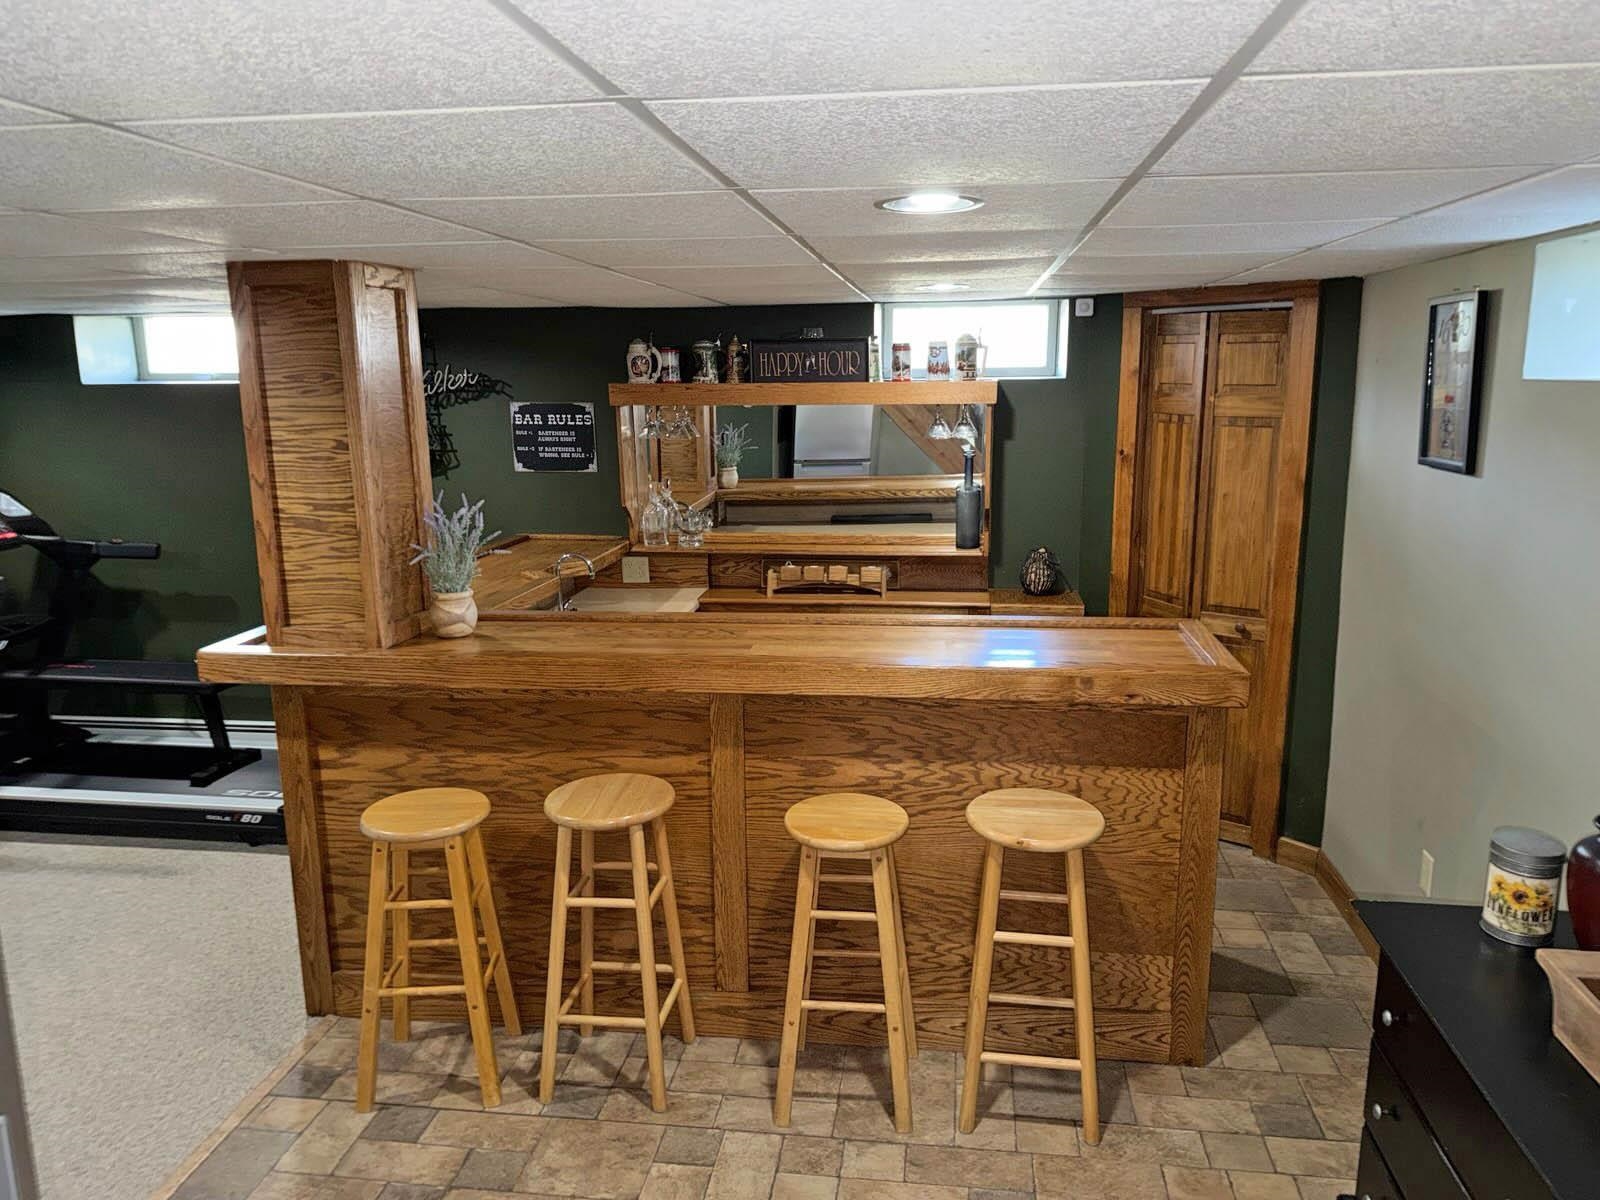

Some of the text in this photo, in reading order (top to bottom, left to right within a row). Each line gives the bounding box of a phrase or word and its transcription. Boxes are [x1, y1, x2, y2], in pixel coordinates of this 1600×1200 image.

[760, 350, 860, 377] HAPPY HOUR
[514, 413, 592, 425] BAR RULES
